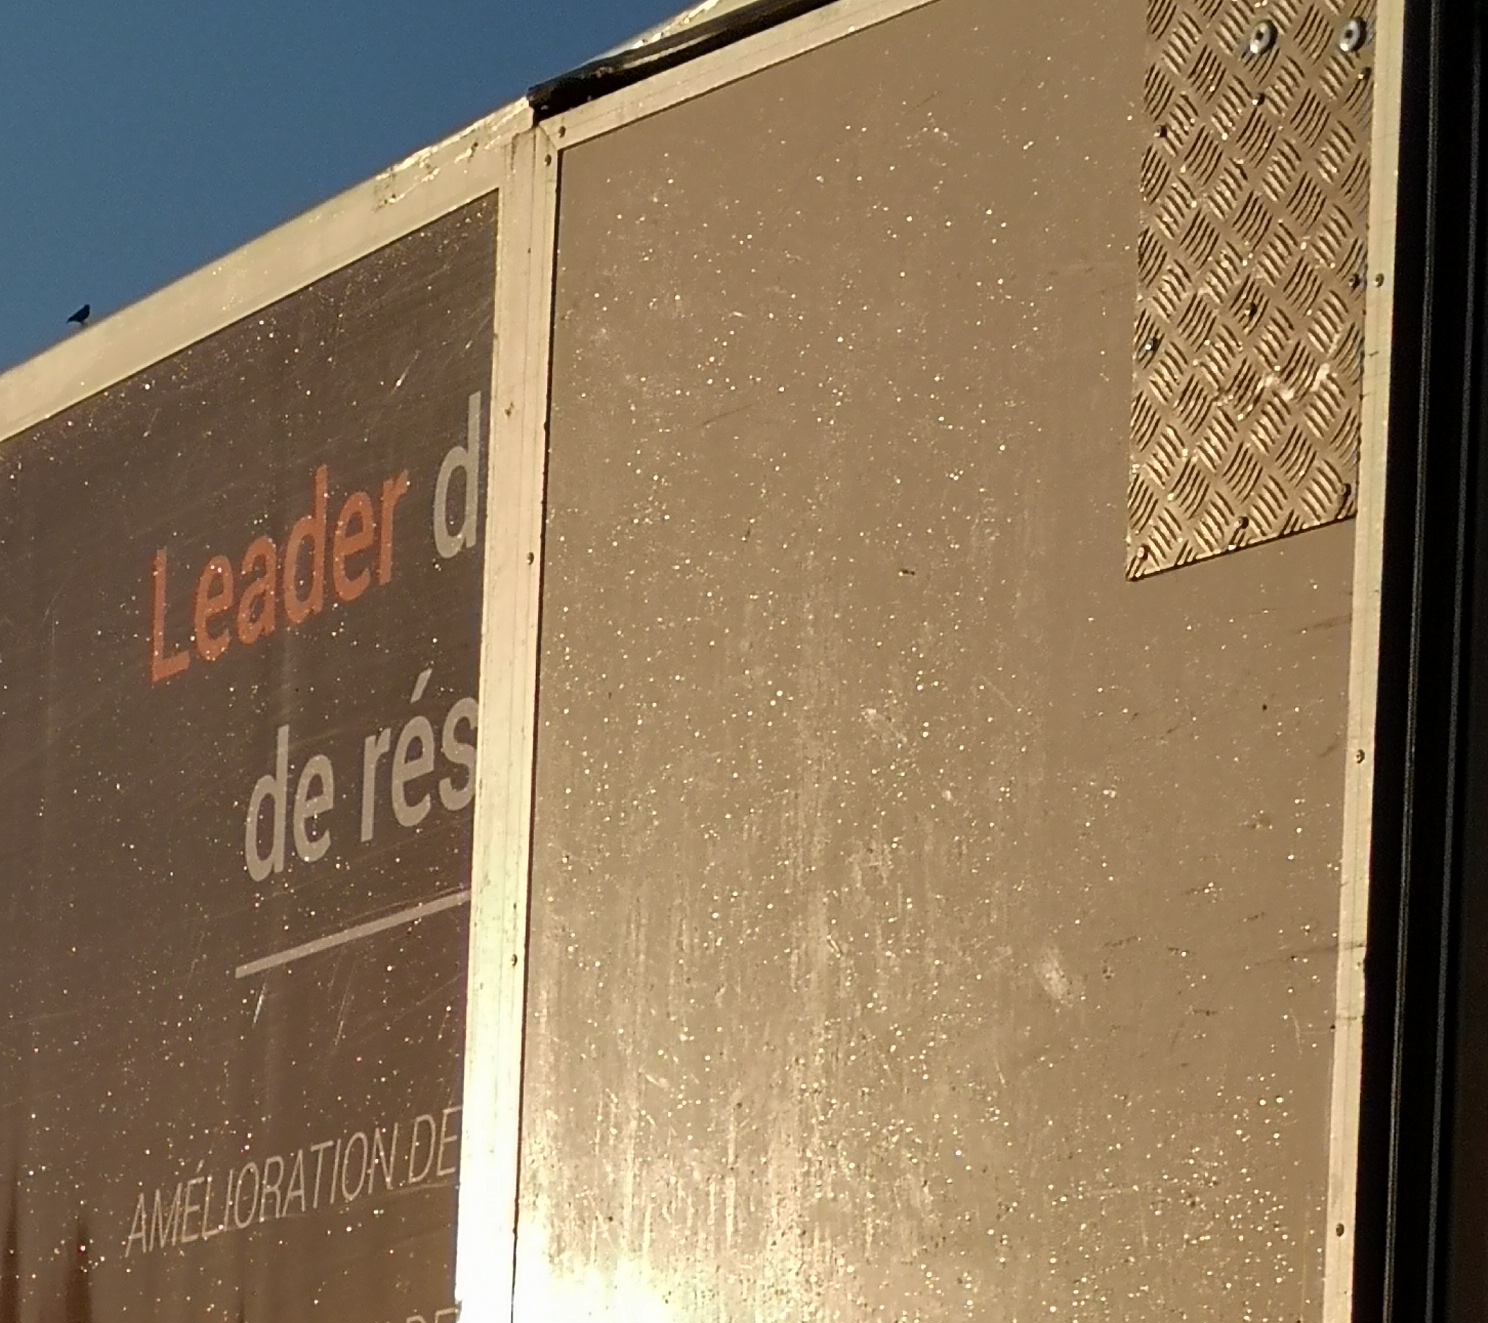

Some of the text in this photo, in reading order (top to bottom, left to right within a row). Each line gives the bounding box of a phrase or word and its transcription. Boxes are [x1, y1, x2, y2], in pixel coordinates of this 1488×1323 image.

[148, 391, 481, 682] Leader d
[245, 668, 479, 882] de rés
[125, 1106, 463, 1258] AMÉLIORATION DE
